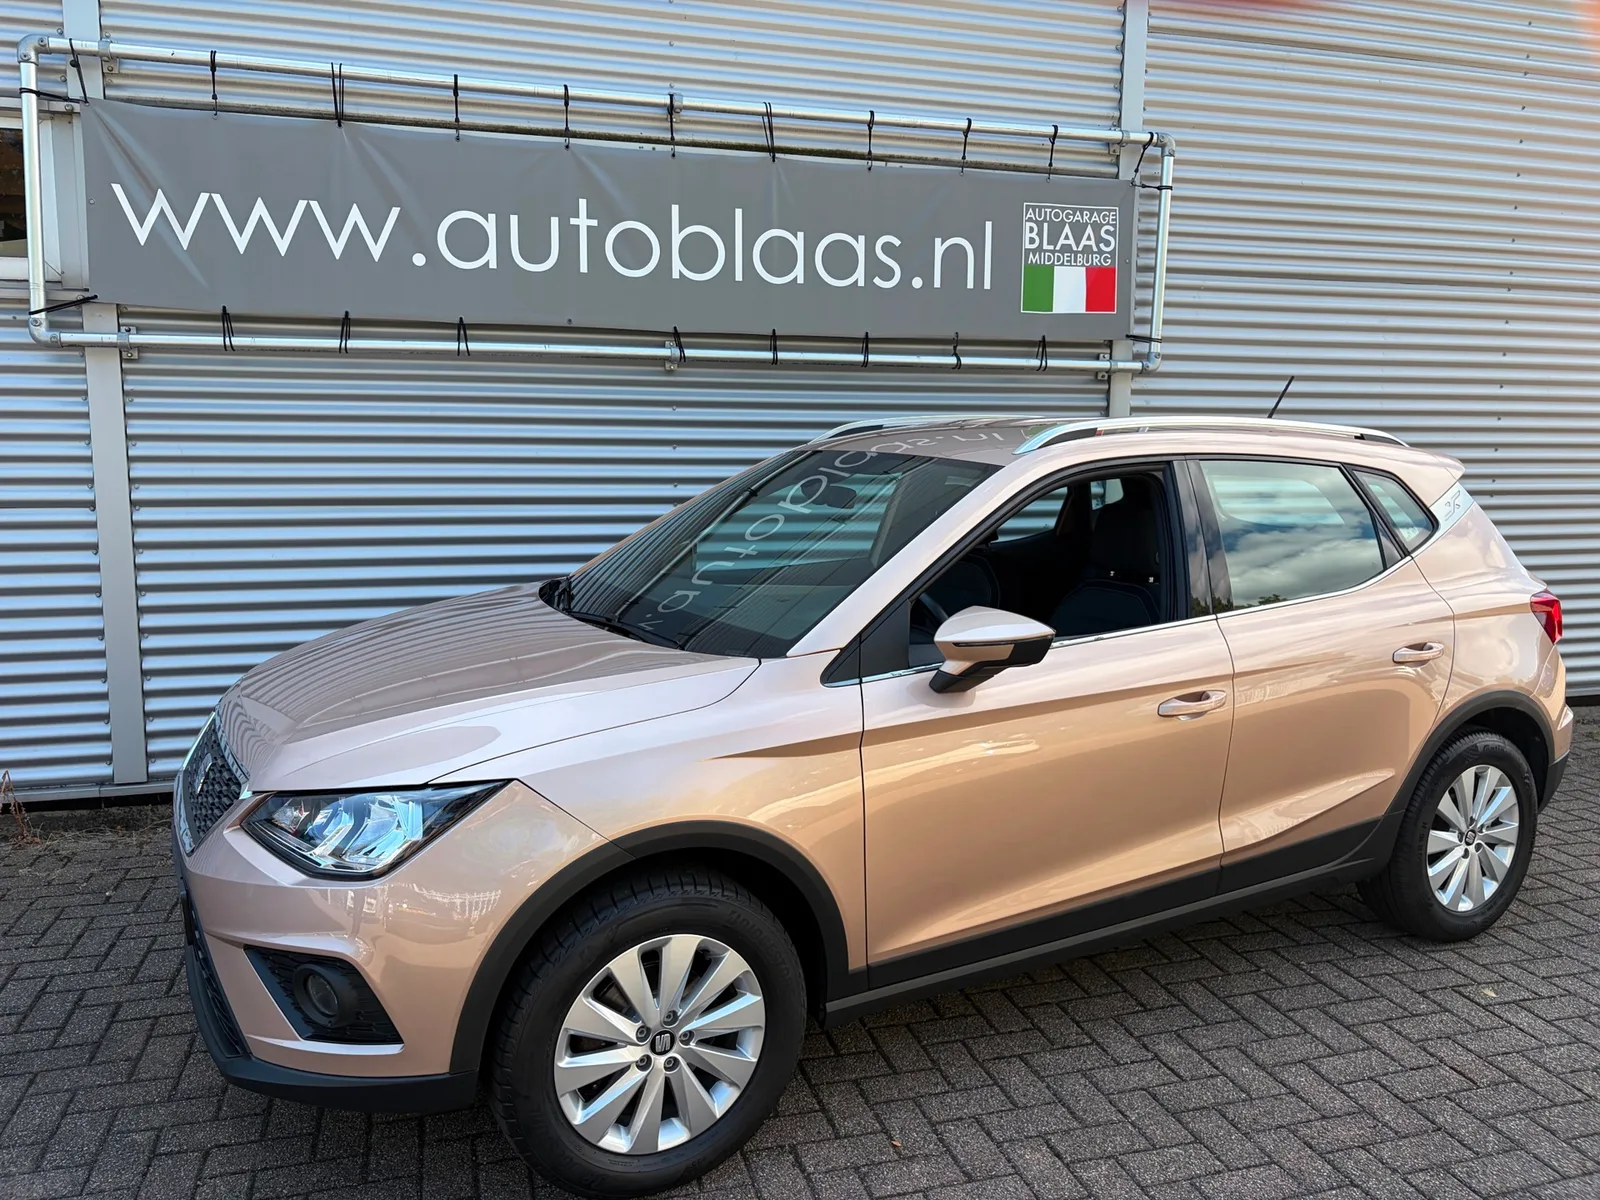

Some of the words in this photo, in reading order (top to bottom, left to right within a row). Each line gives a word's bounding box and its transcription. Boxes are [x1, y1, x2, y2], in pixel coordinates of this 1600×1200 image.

[1025, 207, 1117, 224] AUTOGARAGE
[110, 183, 993, 290] www.autoblaas.nl
[1024, 221, 1116, 252] BLAAS
[1028, 251, 1112, 266] MIDDELBURG
